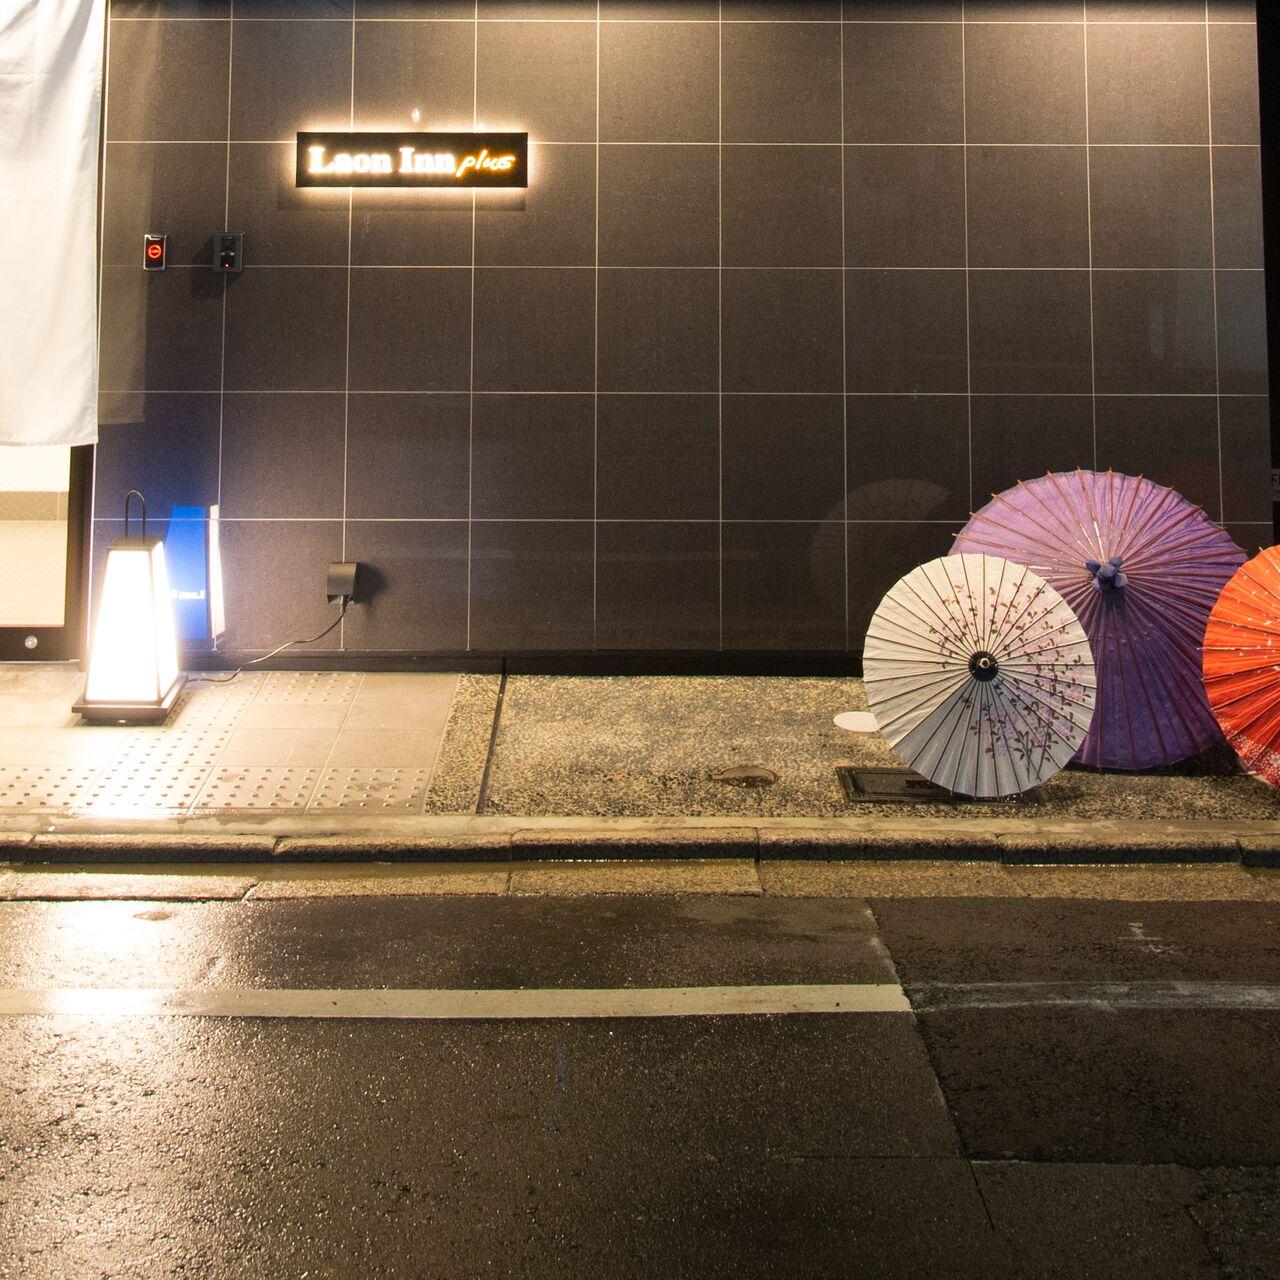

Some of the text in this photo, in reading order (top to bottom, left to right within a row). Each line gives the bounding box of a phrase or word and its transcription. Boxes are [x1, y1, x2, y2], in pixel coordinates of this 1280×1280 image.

[308, 146, 516, 178] Laon Inn plus
